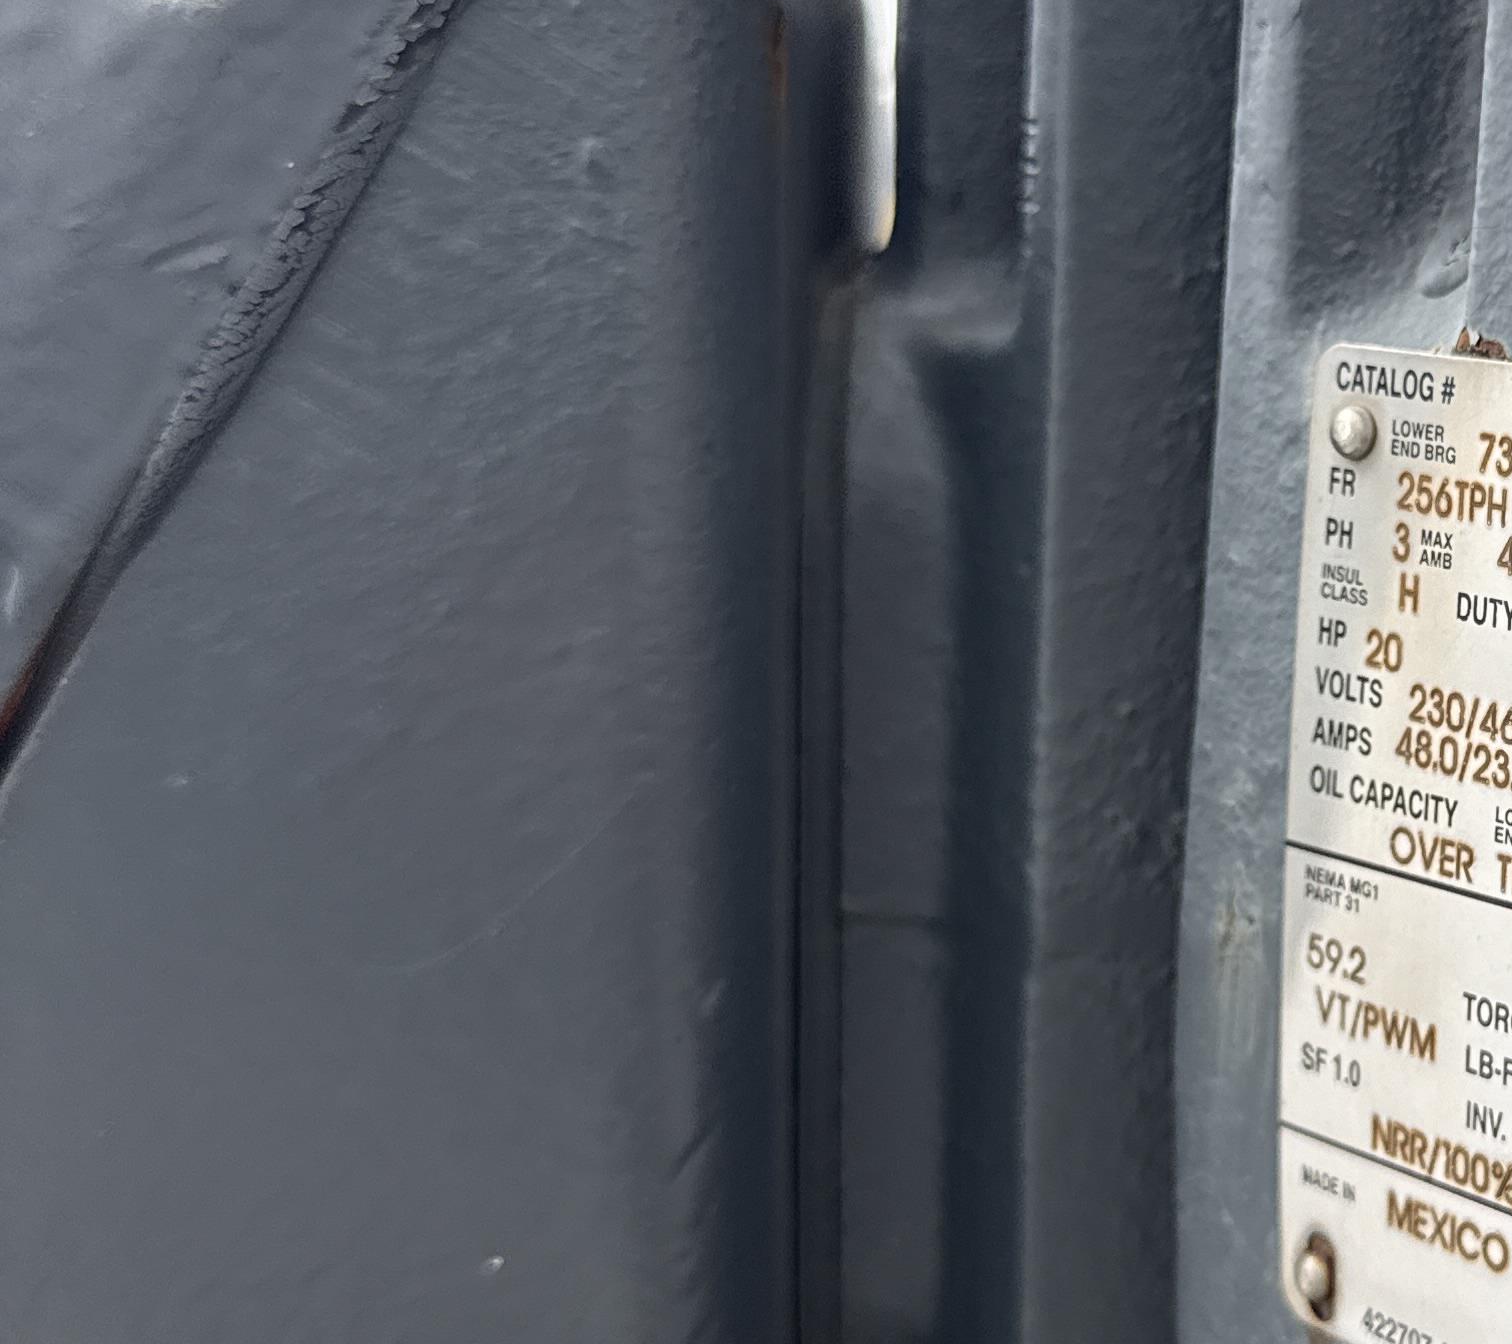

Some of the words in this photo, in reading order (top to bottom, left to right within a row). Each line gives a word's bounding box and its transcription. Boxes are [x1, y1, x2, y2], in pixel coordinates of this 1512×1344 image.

[1335, 361, 1435, 403] CATALOG
[1441, 376, 1456, 401] #
[1392, 419, 1445, 443] LOWER
[1391, 440, 1422, 460] END
[1424, 445, 1457, 464] BRG
[1328, 467, 1356, 497] FR
[1396, 472, 1509, 527] 256TPH
[1325, 518, 1354, 549] PH
[1393, 522, 1410, 564] 3
[1421, 529, 1453, 552] MAX
[1321, 564, 1363, 586] INSUL
[1419, 549, 1453, 569] AMB
[1320, 583, 1368, 606] CLASS
[1398, 572, 1421, 616] H
[1318, 617, 1348, 648] HP
[1365, 629, 1404, 673] 20
[1316, 666, 1383, 708] VOLTS
[1311, 717, 1373, 756] AMPS
[1310, 765, 1344, 800] OIL
[1350, 775, 1459, 827] CAPACITY
[1389, 826, 1475, 884] OVER
[1305, 864, 1346, 890] NEMA
[1350, 876, 1379, 900] MG1
[1305, 883, 1340, 906] PART
[1345, 894, 1360, 912] 31
[1306, 932, 1368, 986] 59.2
[1315, 985, 1438, 1063] VT/PWM
[1301, 1041, 1329, 1074] SF
[1332, 1052, 1361, 1087] 1.0
[1465, 1099, 1507, 1142] INV.
[1302, 1163, 1339, 1195] MADE
[1386, 1189, 1511, 1274] MEXICO
